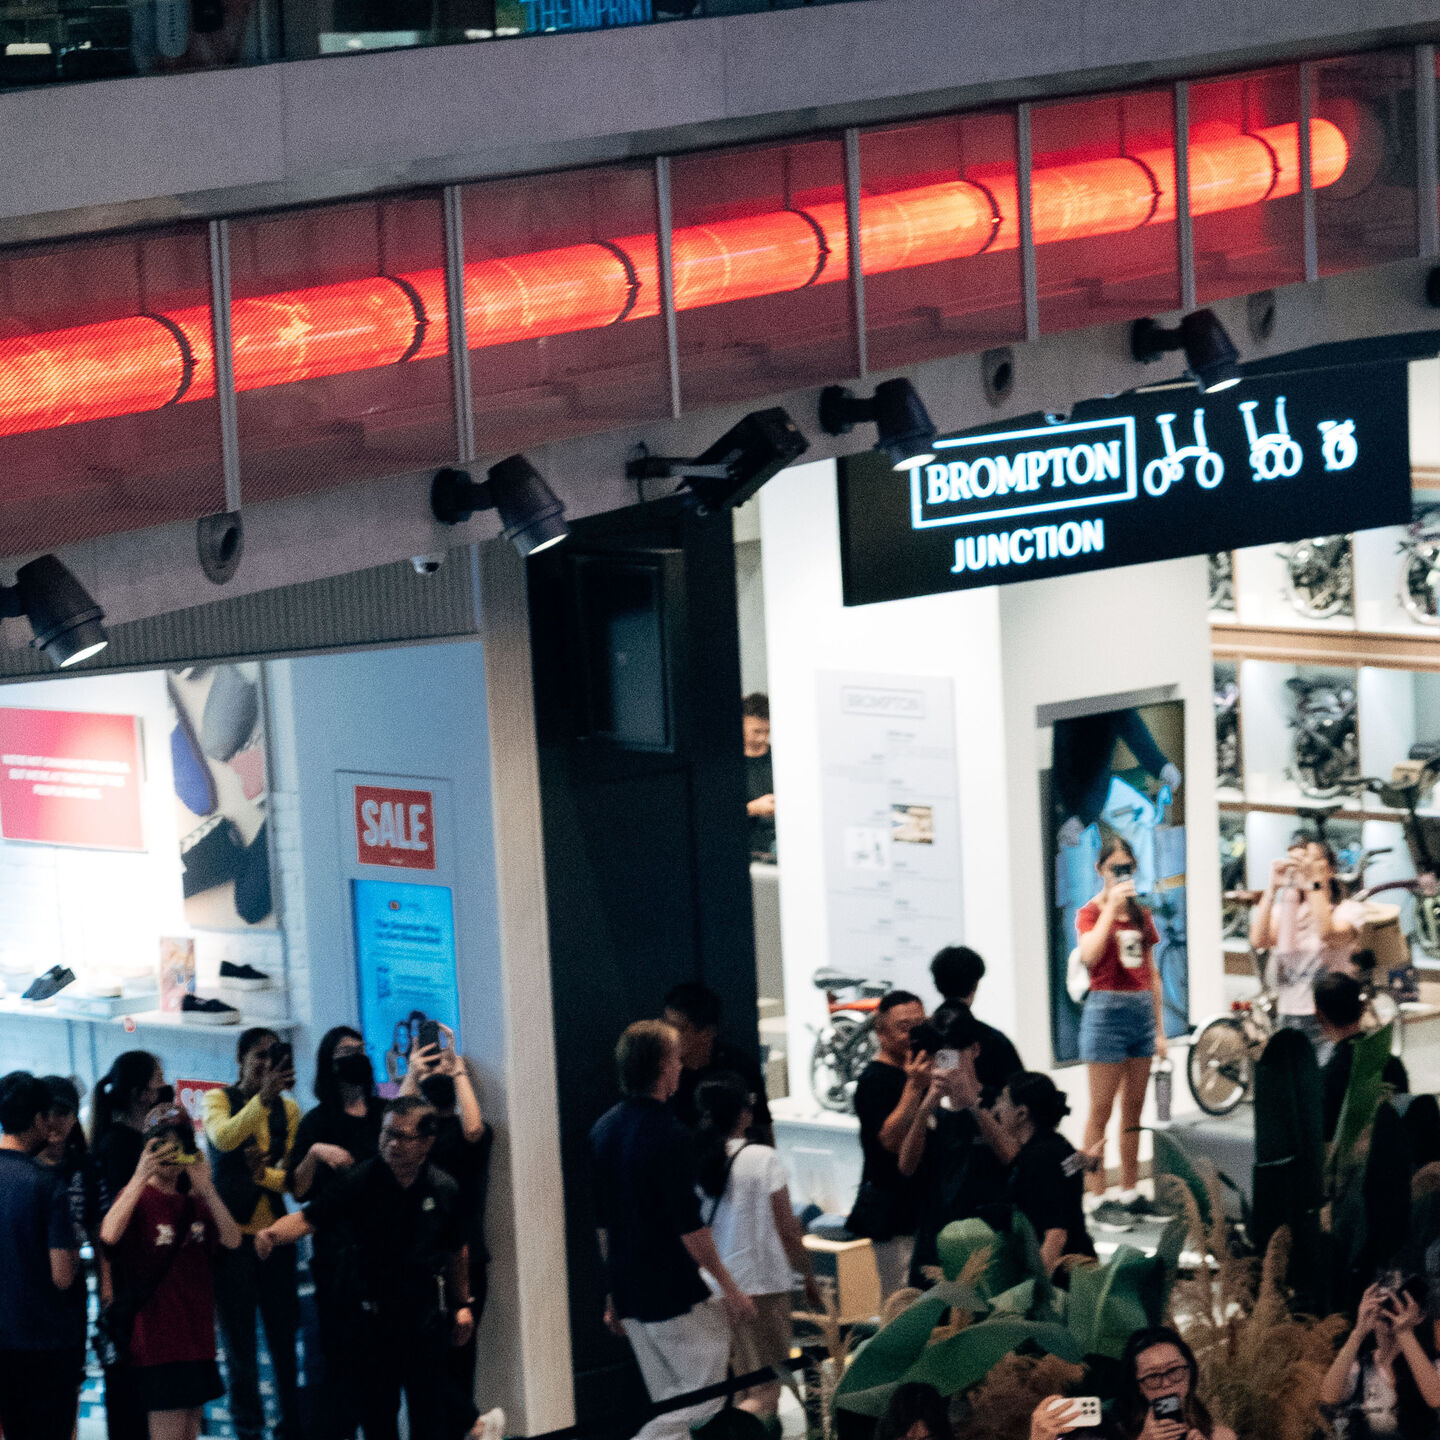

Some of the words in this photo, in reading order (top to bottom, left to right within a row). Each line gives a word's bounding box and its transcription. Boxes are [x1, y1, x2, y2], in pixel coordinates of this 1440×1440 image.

[925, 440, 1122, 505] BROMPTON
[950, 518, 1105, 574] JUNCTION
[361, 799, 428, 851] SALE
